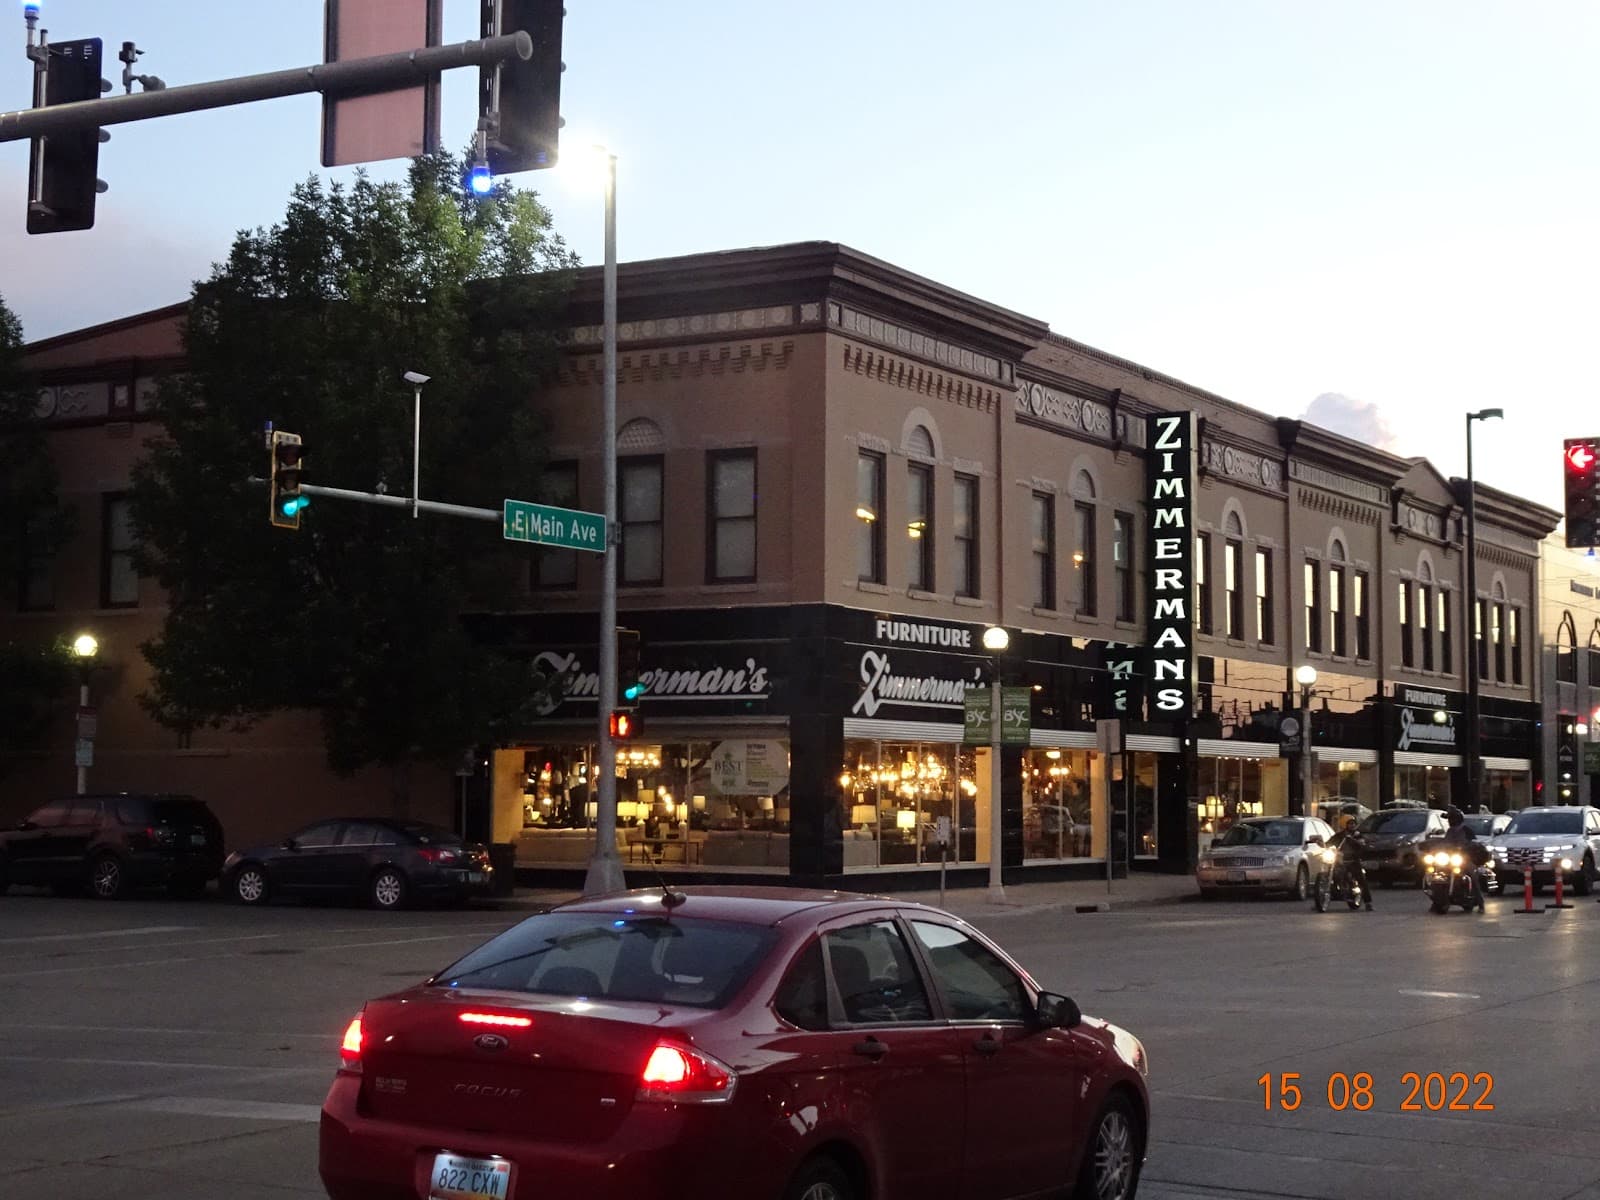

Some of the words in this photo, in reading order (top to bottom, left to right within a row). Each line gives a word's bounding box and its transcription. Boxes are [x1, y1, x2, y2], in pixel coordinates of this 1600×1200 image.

[515, 510, 525, 532] E
[531, 512, 564, 539] Main
[570, 519, 597, 543] Ave
[1154, 416, 1186, 711] ZIMMERMANS
[876, 619, 972, 648] FURNITURE
[439, 1167, 468, 1192] 822
[471, 1172, 501, 1196] CXW
